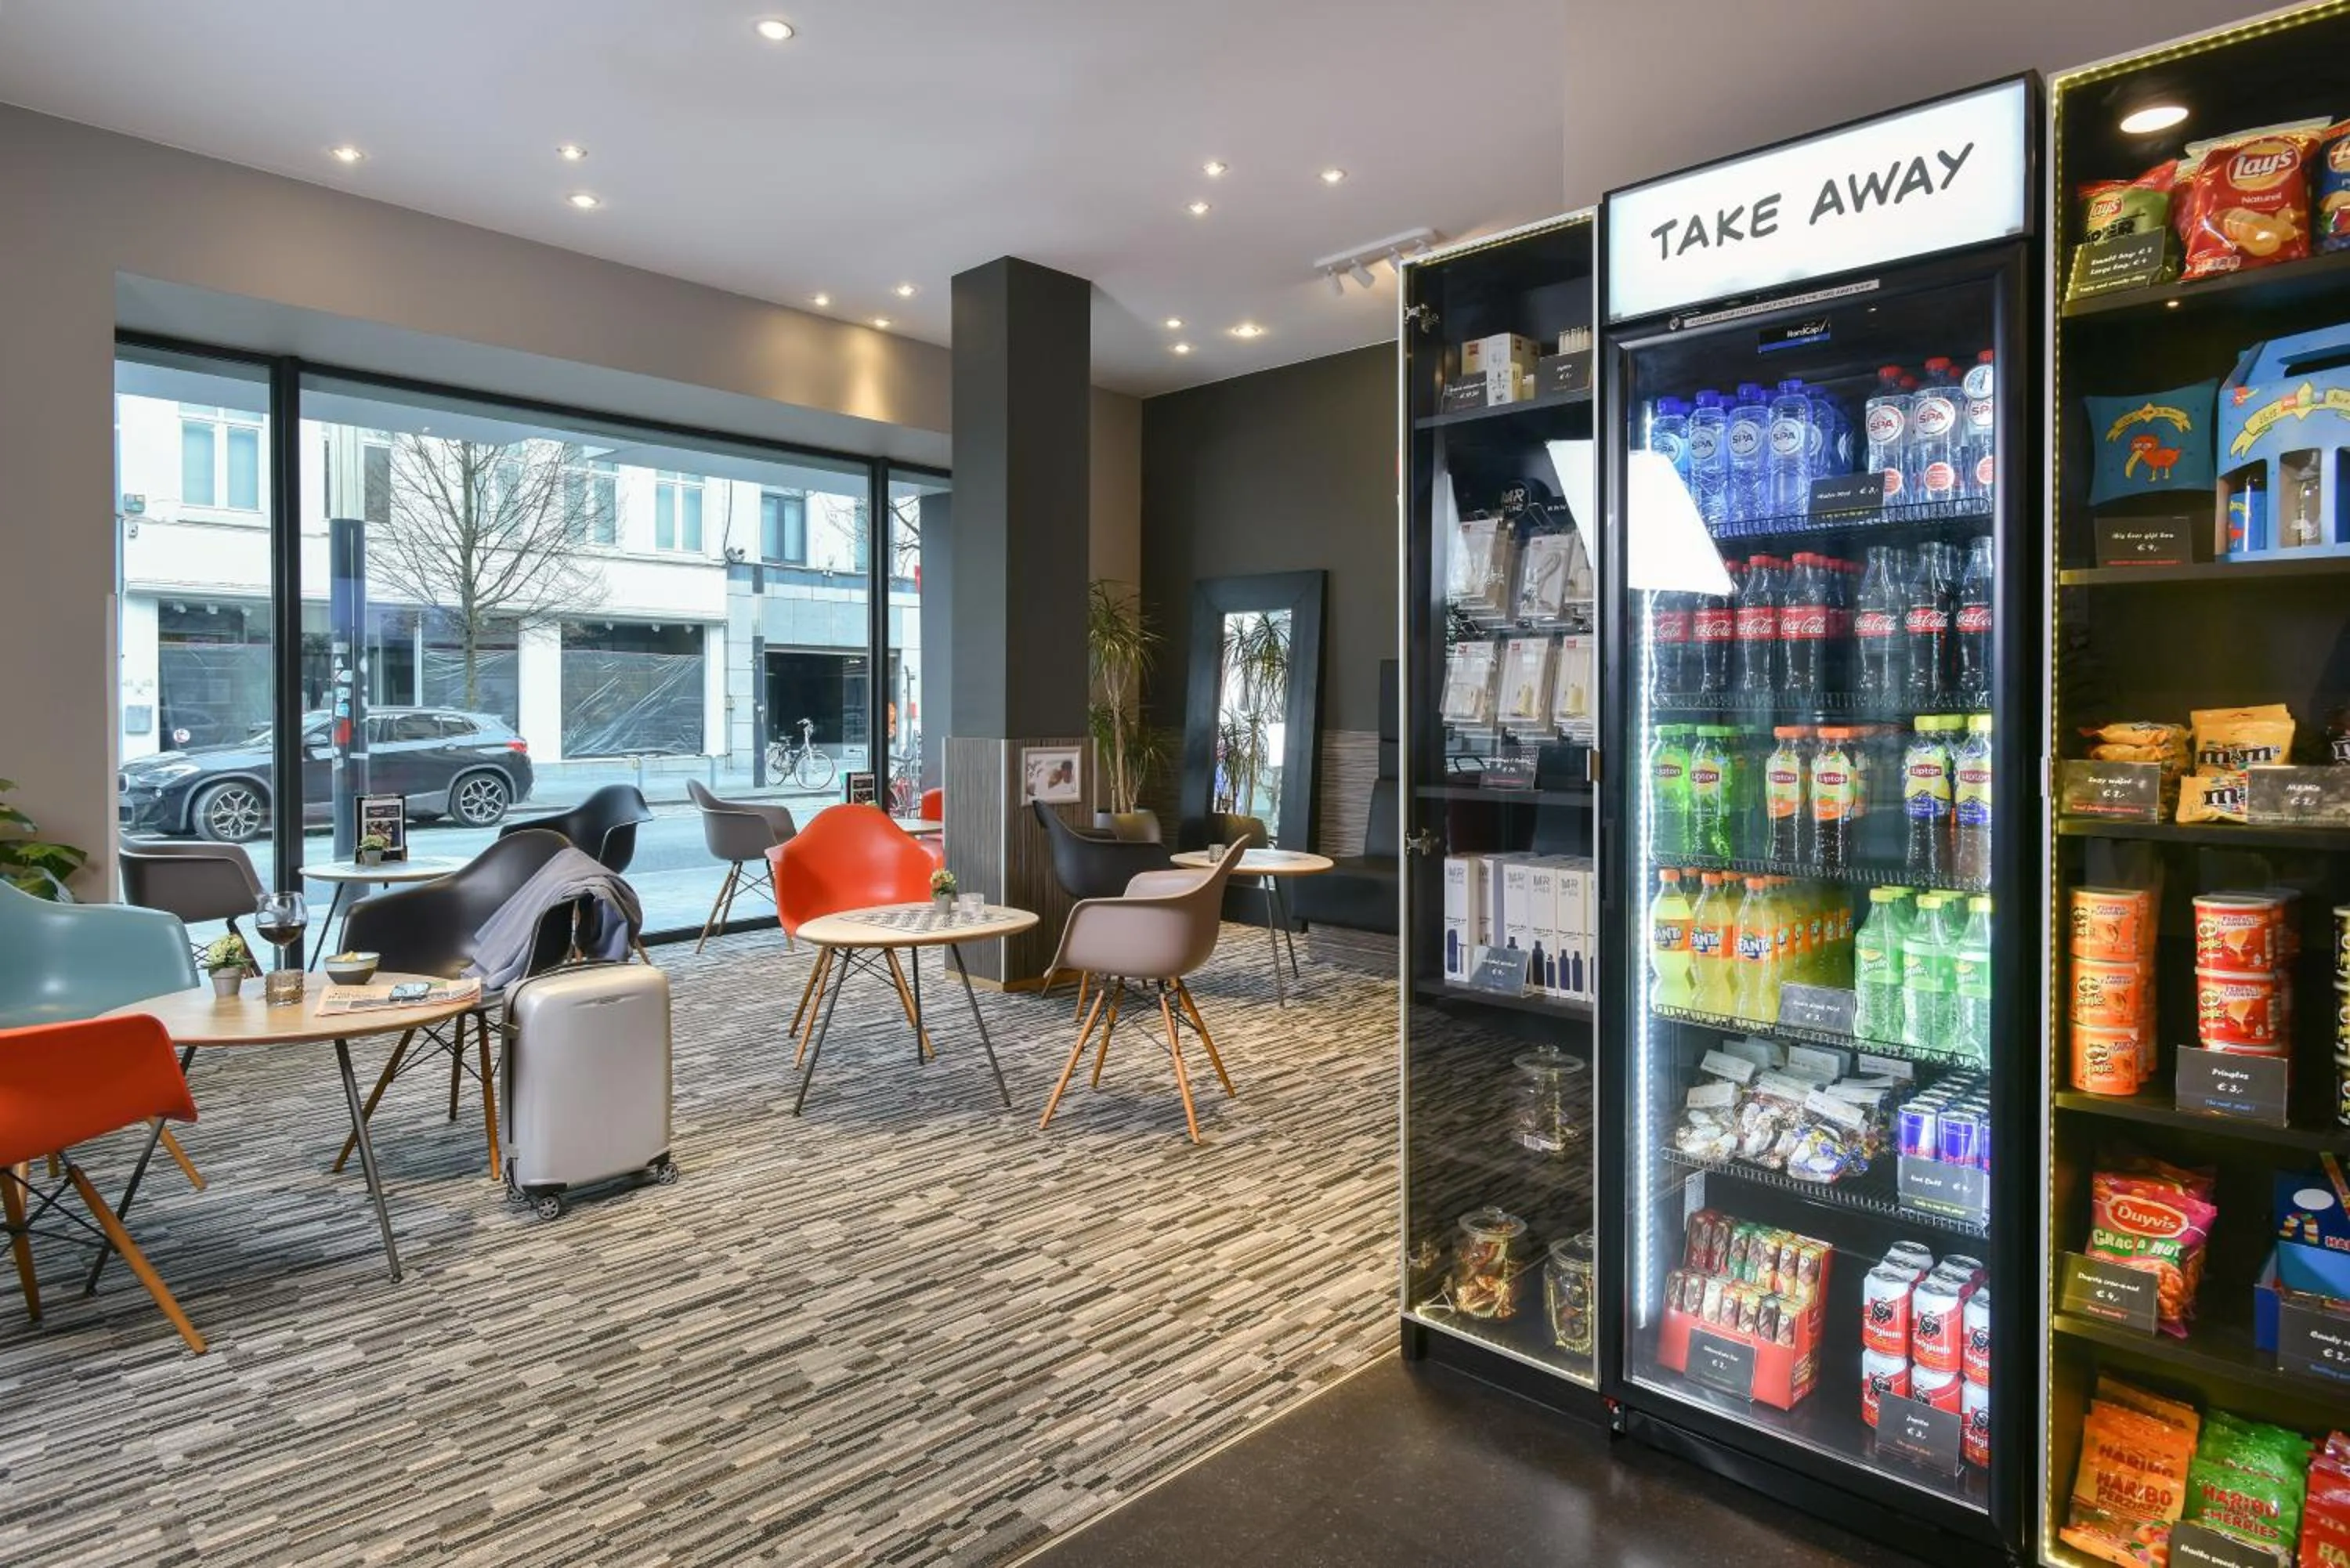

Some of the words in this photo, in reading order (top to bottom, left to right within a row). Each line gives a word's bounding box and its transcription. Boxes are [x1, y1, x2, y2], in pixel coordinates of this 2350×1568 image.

[1650, 193, 1782, 260] TAKE
[1810, 142, 1975, 226] AWAY
[1919, 411, 1946, 424] SPA
[1870, 419, 1895, 432] SPA
[1731, 433, 1755, 445] SPA
[1772, 431, 1796, 442] SPA
[1690, 439, 1714, 450] SPA
[1690, 771, 1717, 784] Lipton
[1911, 767, 1941, 776] Lipton
[2211, 1068, 2250, 1080] Pringles
[2117, 1204, 2177, 1230] Duyvis
[2149, 1241, 2184, 1258] NUT
